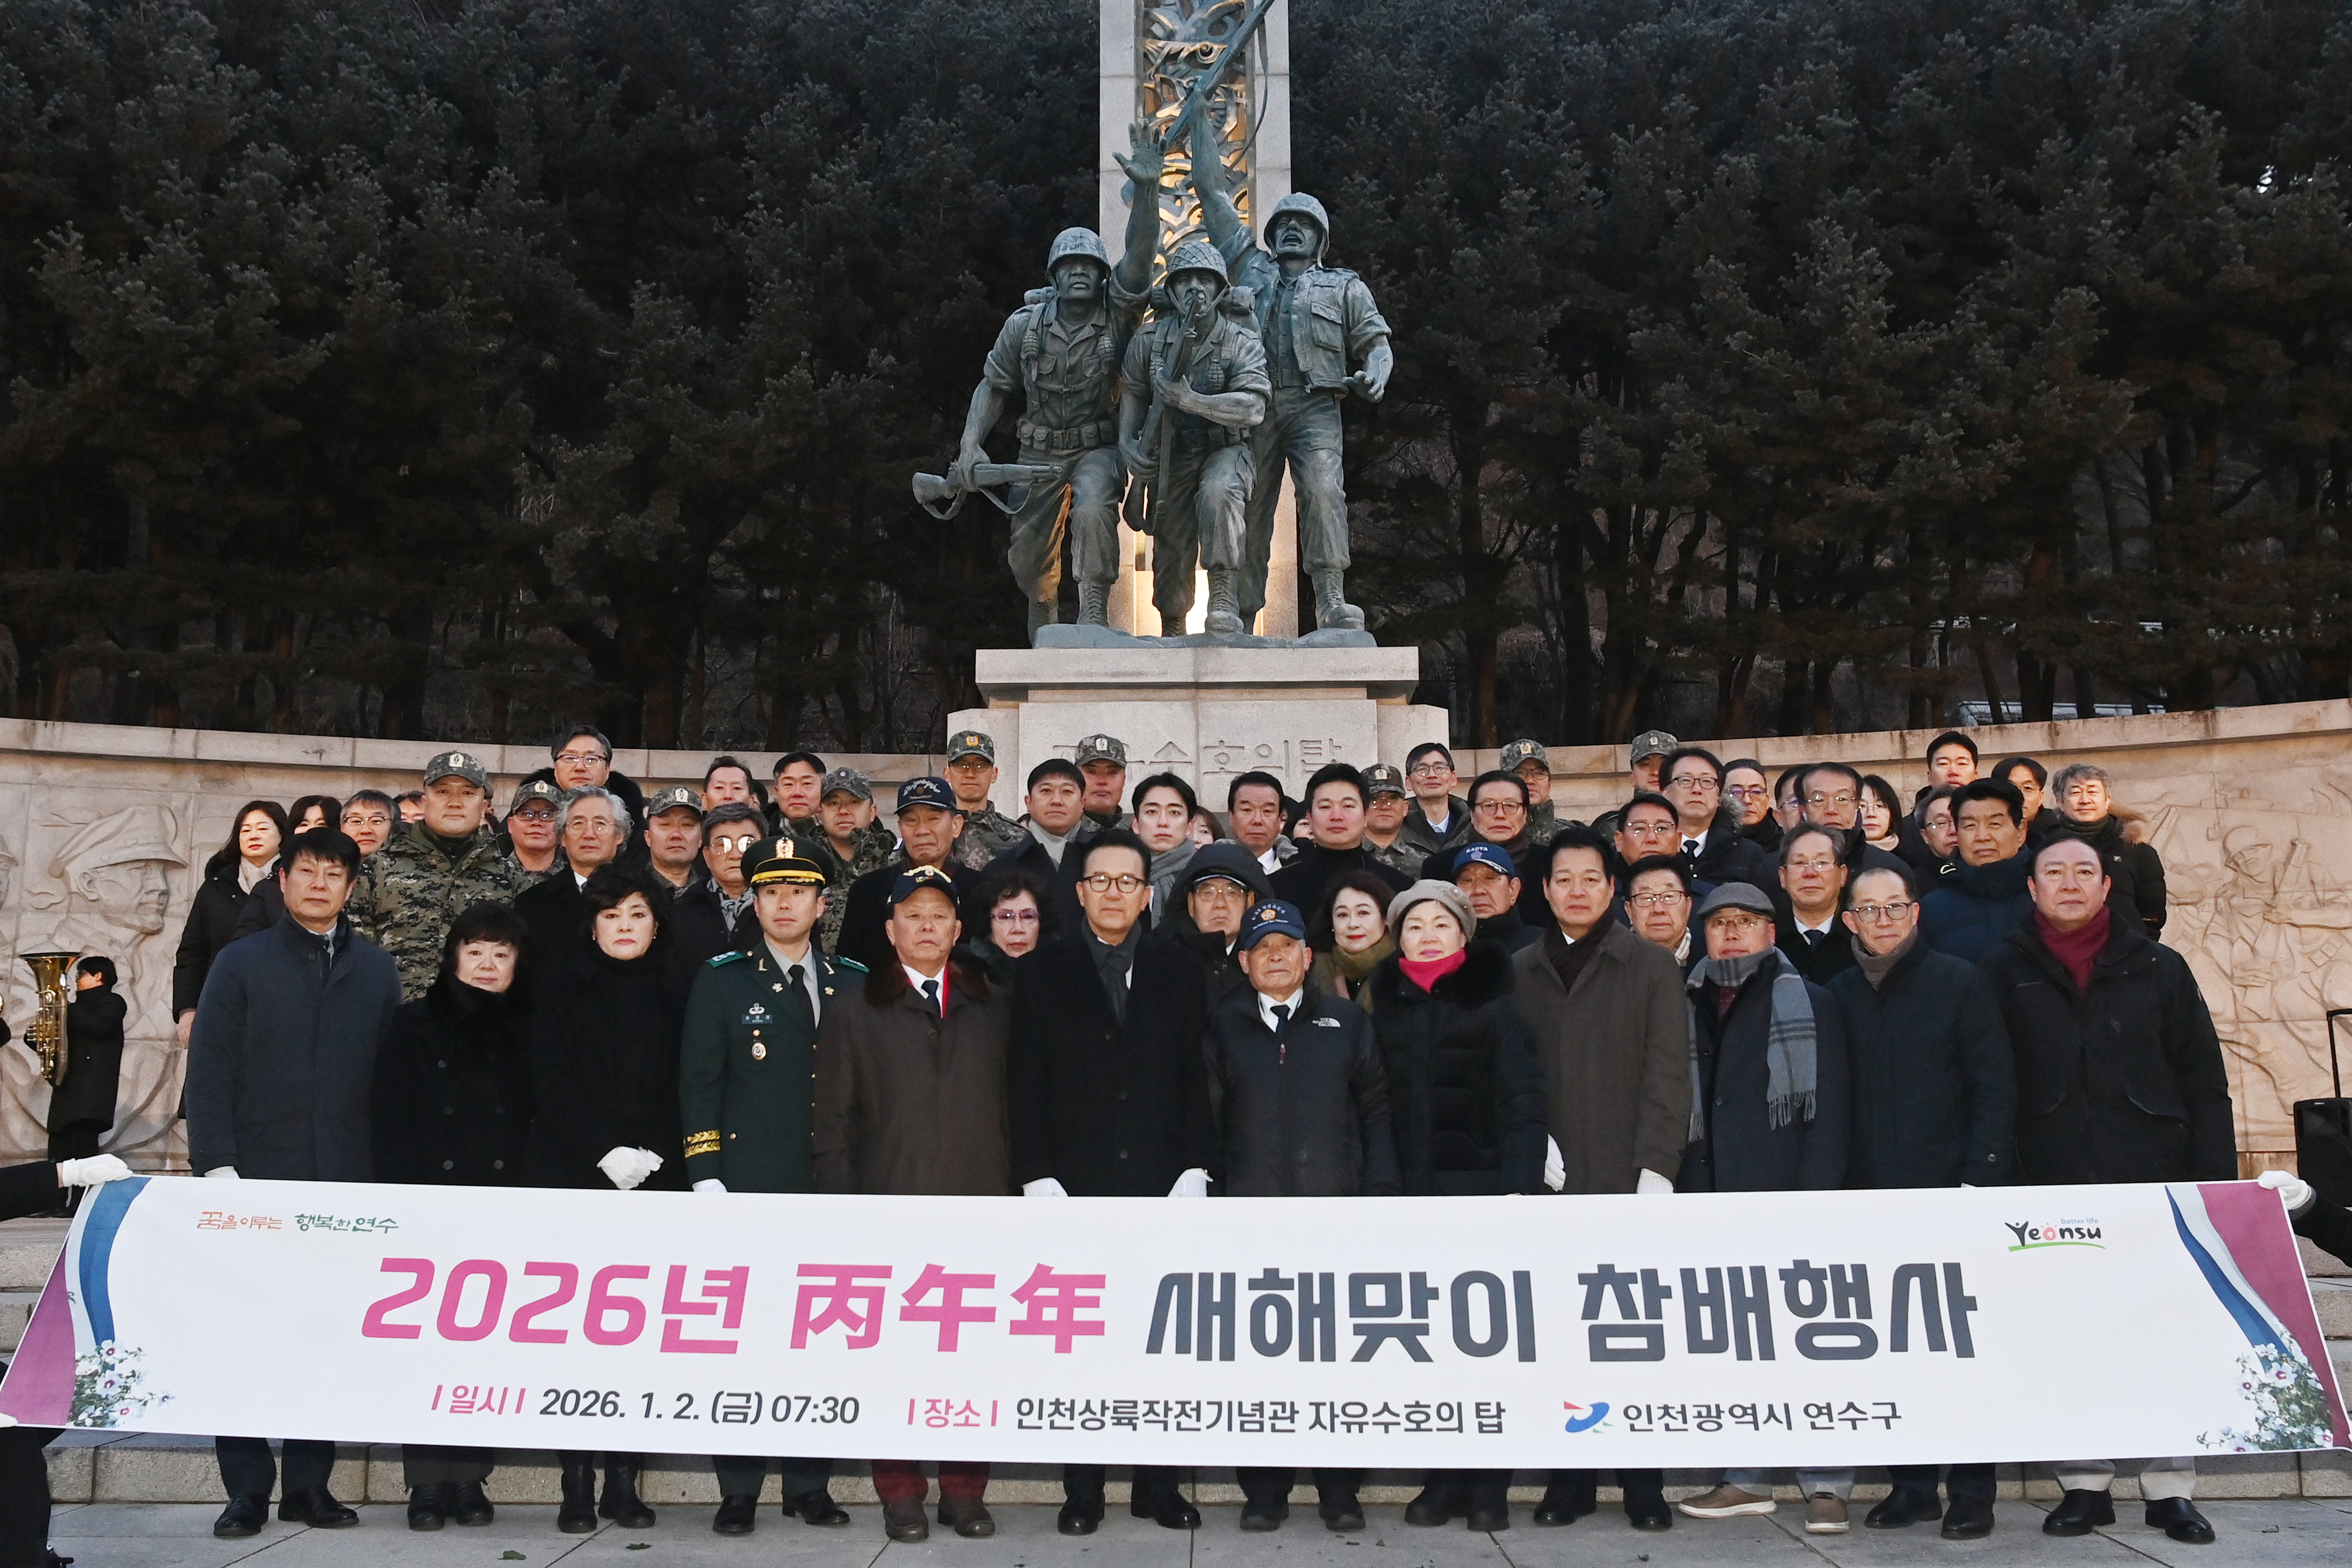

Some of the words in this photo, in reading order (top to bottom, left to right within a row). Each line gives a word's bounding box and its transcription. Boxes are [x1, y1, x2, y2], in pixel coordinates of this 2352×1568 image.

[197, 1211, 237, 1230] 꿈을
[240, 1216, 282, 1230] 이루는
[294, 1214, 351, 1232] 행복한
[352, 1217, 399, 1234] 연수
[2004, 1220, 2102, 1247] Yeonsu
[361, 1257, 750, 1354] 2026년
[789, 1263, 1107, 1354] 丙午年
[1145, 1267, 1537, 1363] 새해맞이
[1577, 1259, 1978, 1363] 참배행사
[539, 1388, 626, 1418] 2026.
[641, 1392, 662, 1419] 1.
[771, 1395, 860, 1424] 07:30
[1016, 1397, 1300, 1434] 인천상륙작전기념관
[1308, 1400, 1464, 1434] 자유수호의
[1474, 1401, 1506, 1434] 탑
[1622, 1402, 1793, 1432] 인천광역시
[1803, 1401, 1902, 1431] 연수구
